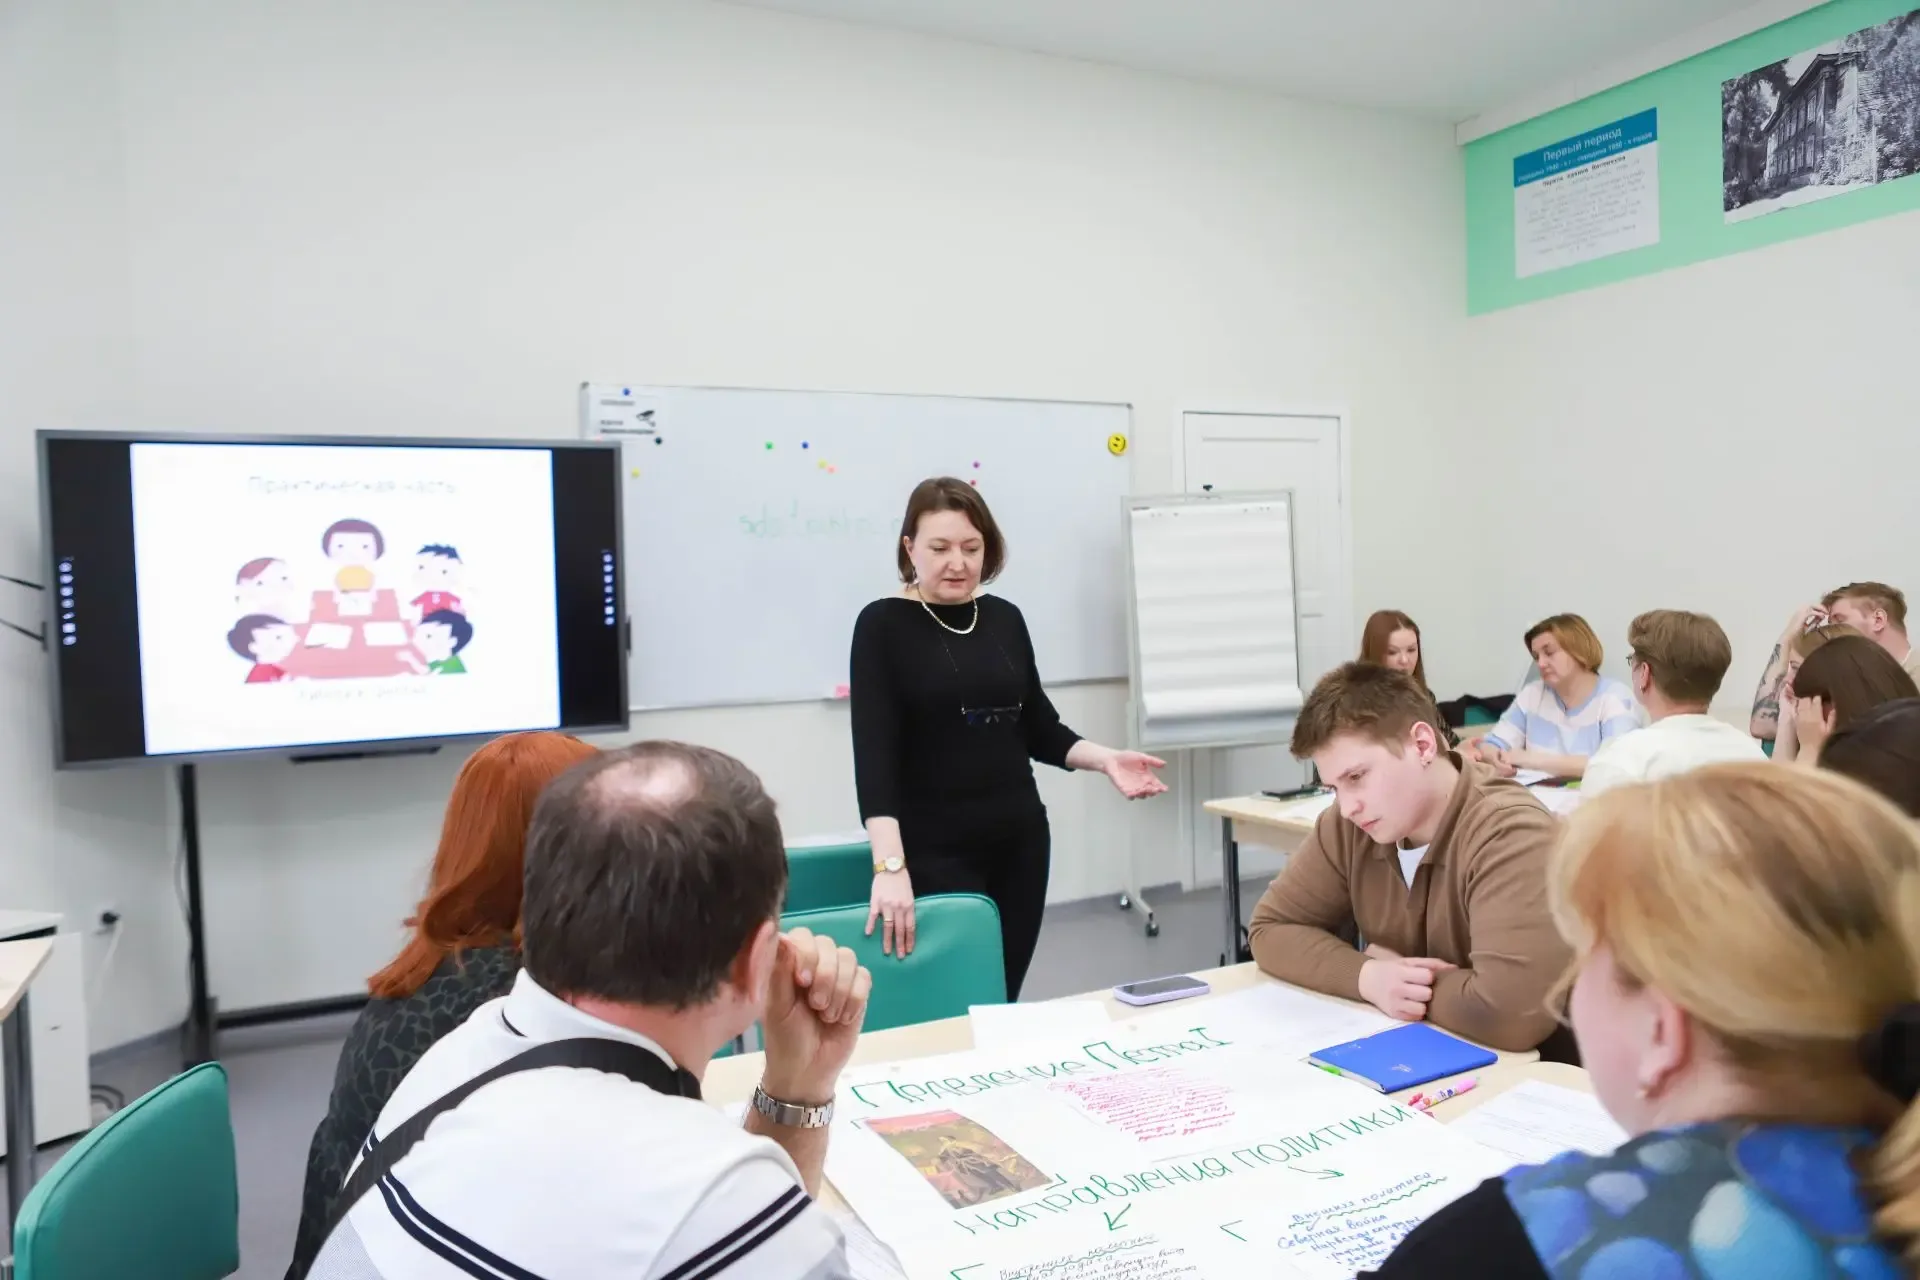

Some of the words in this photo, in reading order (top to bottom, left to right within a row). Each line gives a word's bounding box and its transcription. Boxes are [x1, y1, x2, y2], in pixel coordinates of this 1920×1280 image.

[1543, 139, 1582, 163] Первый
[1584, 127, 1622, 149] период
[953, 1157, 1233, 1235] Направления
